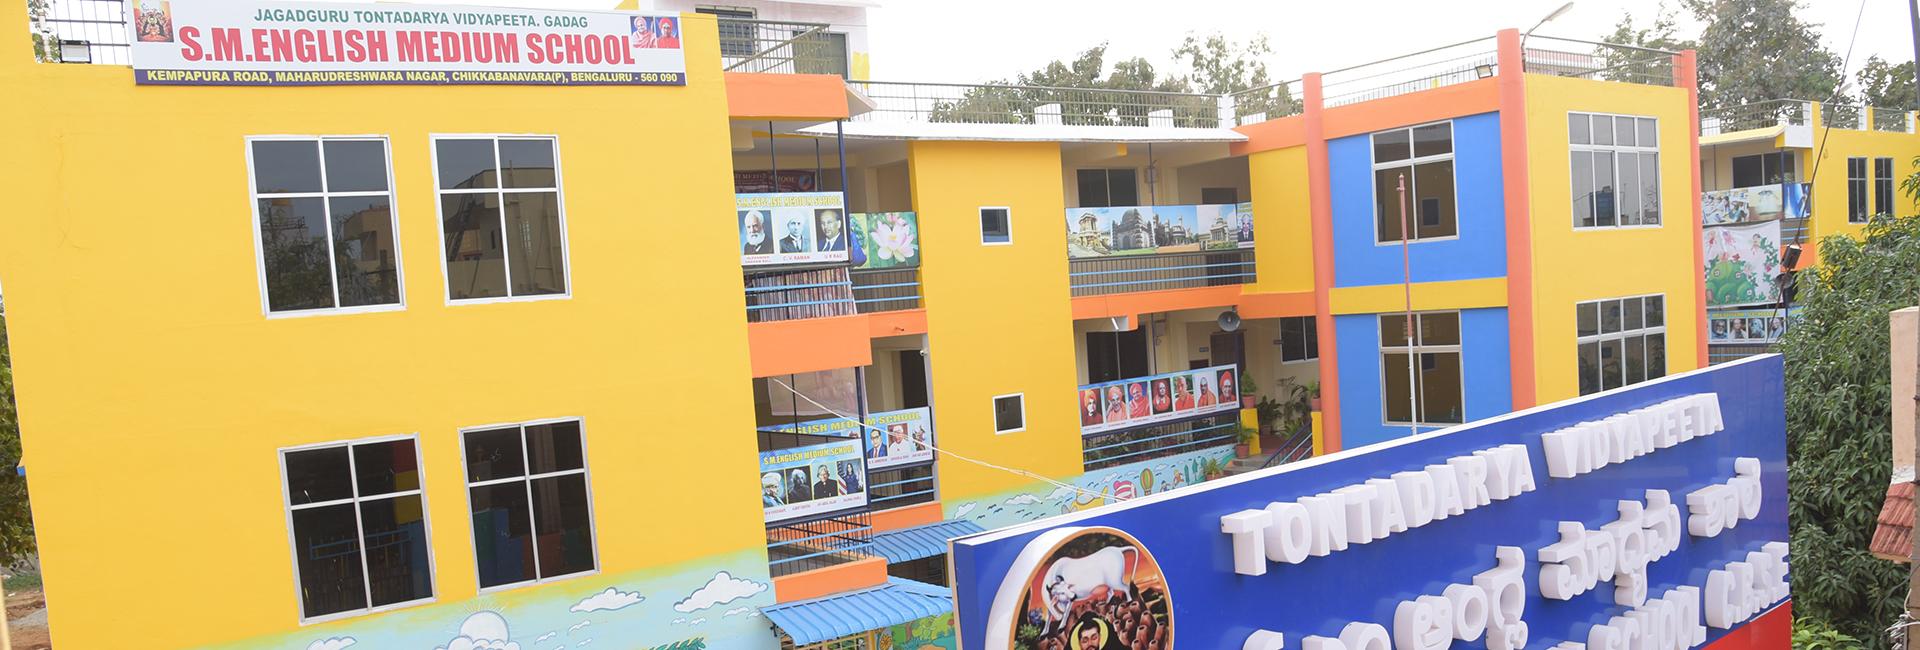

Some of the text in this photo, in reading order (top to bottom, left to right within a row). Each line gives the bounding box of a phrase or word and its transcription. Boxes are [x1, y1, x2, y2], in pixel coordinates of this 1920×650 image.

[254, 8, 588, 28] JAGADGURU TONTADARYA VIDYAPEETA. GADAG
[179, 25, 635, 65] S.M.ENGLISH MEDIUM SCHOOL
[147, 70, 230, 82] KEMPAPURA
[233, 71, 272, 84] ROAD,
[275, 71, 403, 82] MAHARUDRESHWARA
[406, 71, 449, 84] NAGAR,
[571, 72, 632, 83] BENGALURU
[641, 73, 658, 83] 560
[660, 73, 678, 83] 090
[1221, 392, 1724, 576] TONTADARYA VIDYAPEETA
